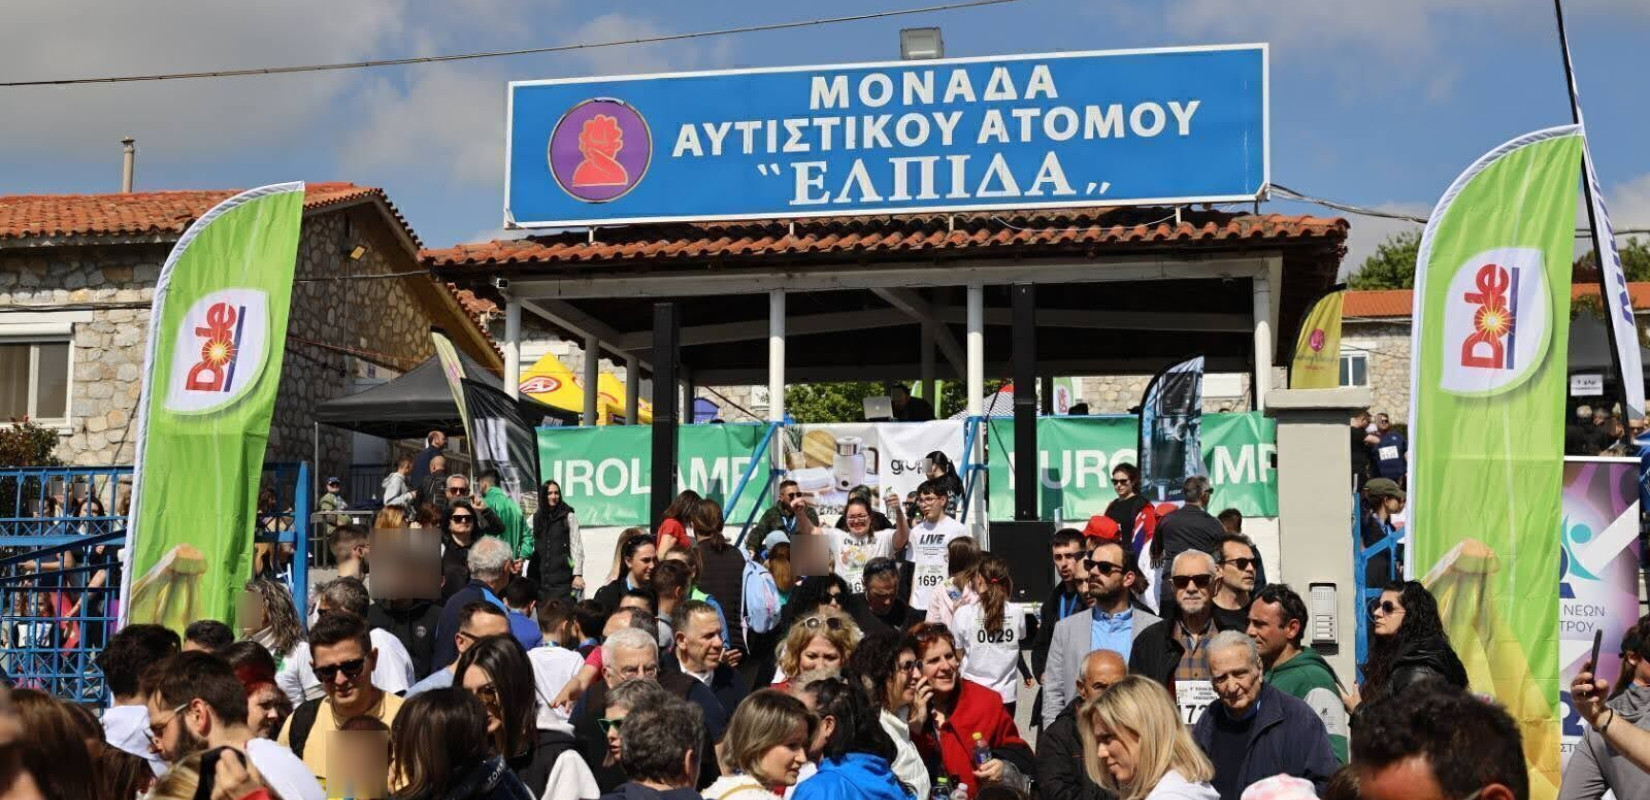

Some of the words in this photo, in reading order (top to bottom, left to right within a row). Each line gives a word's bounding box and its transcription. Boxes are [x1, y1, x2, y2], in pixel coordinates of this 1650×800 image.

[809, 65, 1058, 110] ΜΟΝΑΔΑ
[672, 111, 963, 158] ΑΥΤΙΣΤΙΚΟΥ
[977, 100, 1201, 144] ΑΤΟΜΟΥ
[1461, 263, 1510, 368] Dole
[186, 302, 237, 392] Dole
[919, 533, 945, 545] LIVE
[1563, 604, 1605, 617] ΝΕΩΝ
